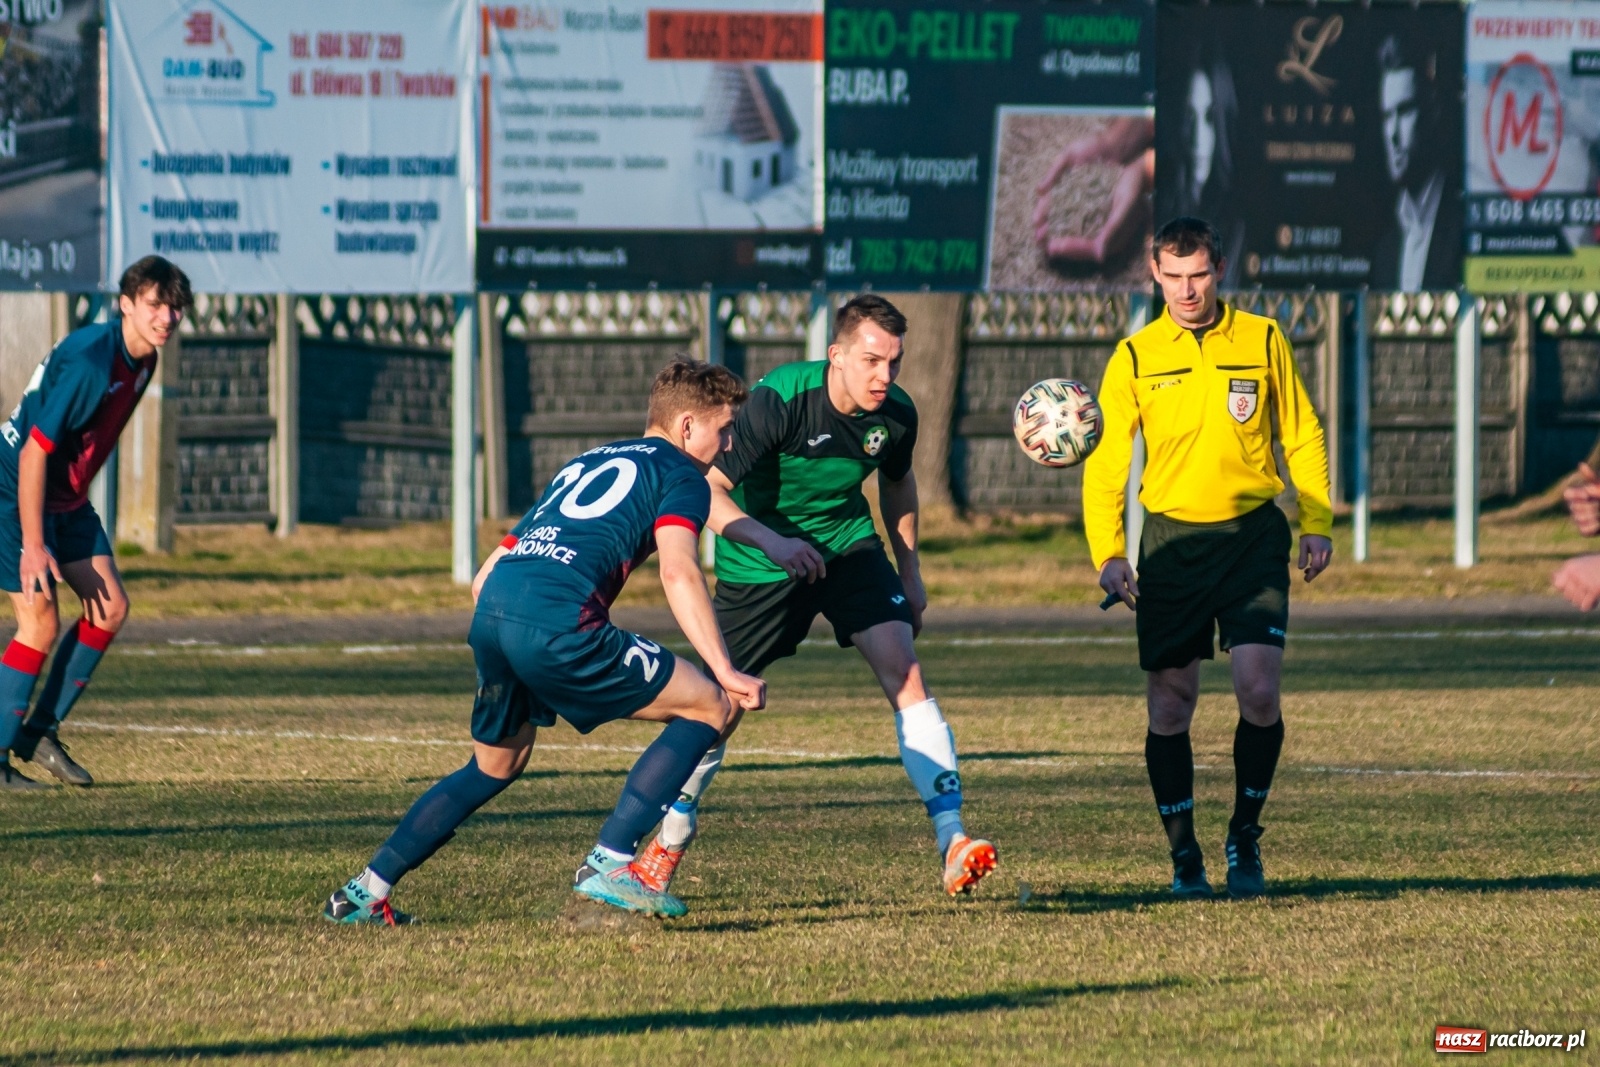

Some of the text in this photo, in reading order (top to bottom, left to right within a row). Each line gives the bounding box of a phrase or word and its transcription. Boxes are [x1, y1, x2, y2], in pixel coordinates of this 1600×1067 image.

[828, 8, 1019, 59] EKO-PELLET
[49, 241, 76, 270] 10
[533, 457, 637, 520] 20
